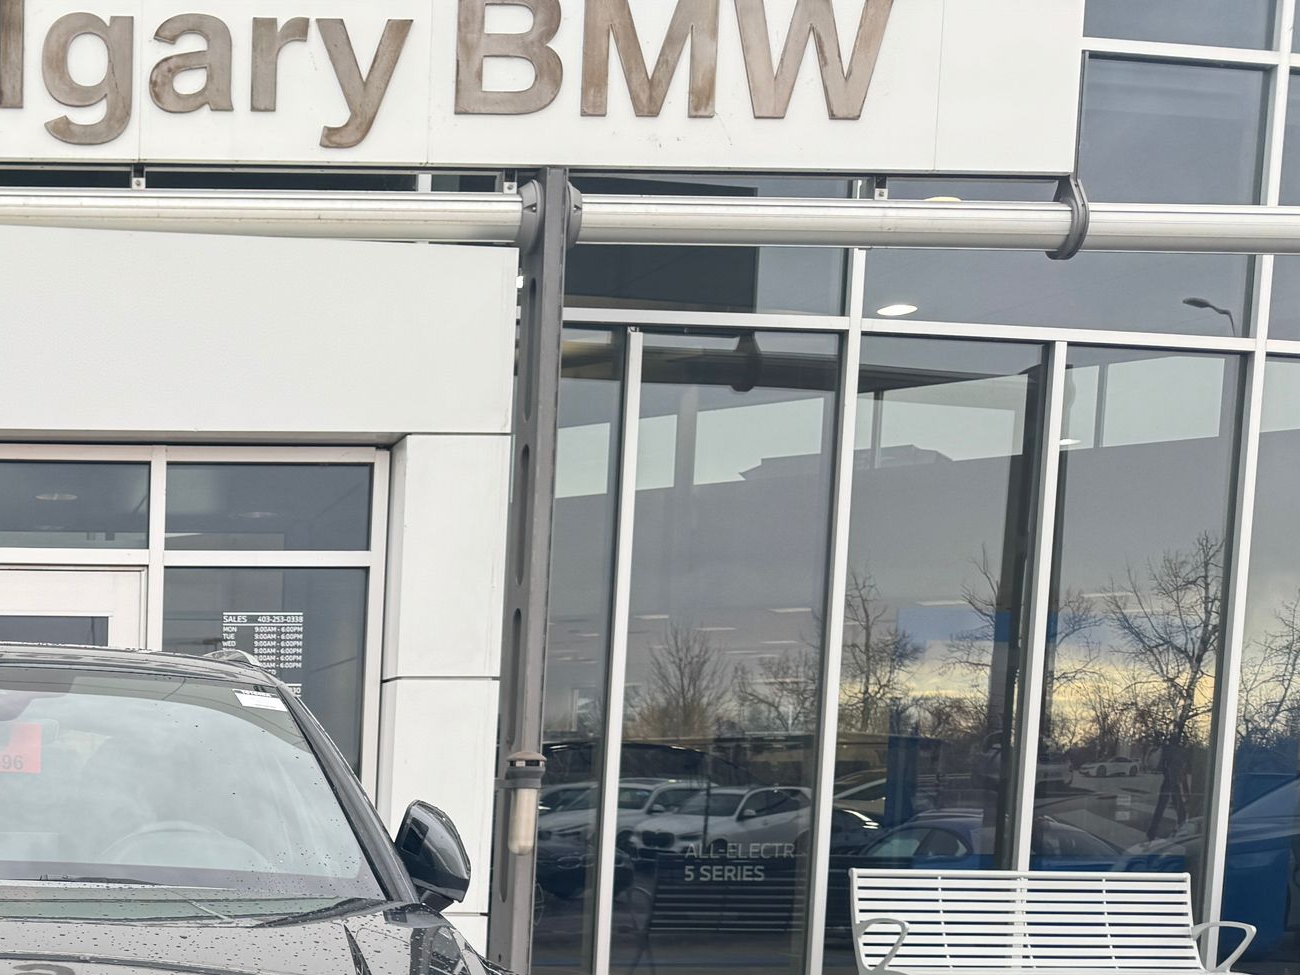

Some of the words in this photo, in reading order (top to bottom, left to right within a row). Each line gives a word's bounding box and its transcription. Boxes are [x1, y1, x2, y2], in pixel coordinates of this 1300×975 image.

[454, 0, 894, 121] BMW
[222, 615, 248, 623] SALES
[684, 865, 695, 881] 5
[699, 865, 765, 881] SERIES
